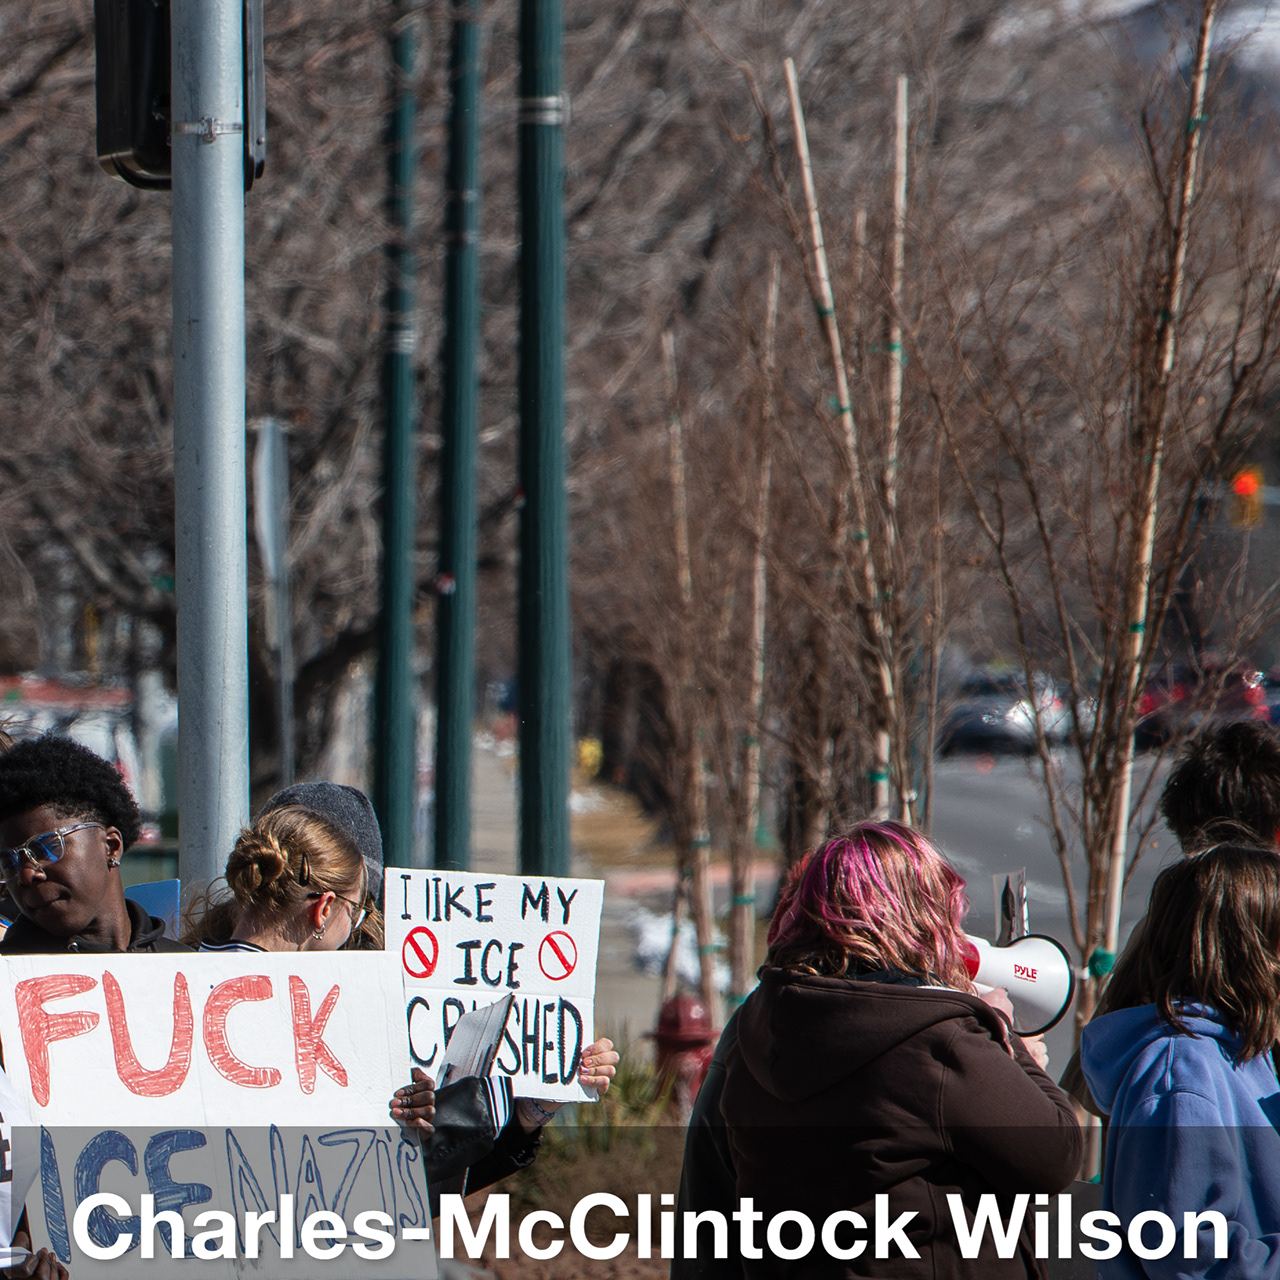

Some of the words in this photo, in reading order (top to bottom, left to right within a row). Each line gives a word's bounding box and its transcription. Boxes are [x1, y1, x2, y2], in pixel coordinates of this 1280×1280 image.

[400, 874, 412, 921] I
[521, 881, 579, 925] MY
[453, 938, 525, 990] ICE
[14, 969, 350, 1108] FUCK
[406, 994, 584, 1086] CRSHED
[40, 1125, 219, 1264] ICE
